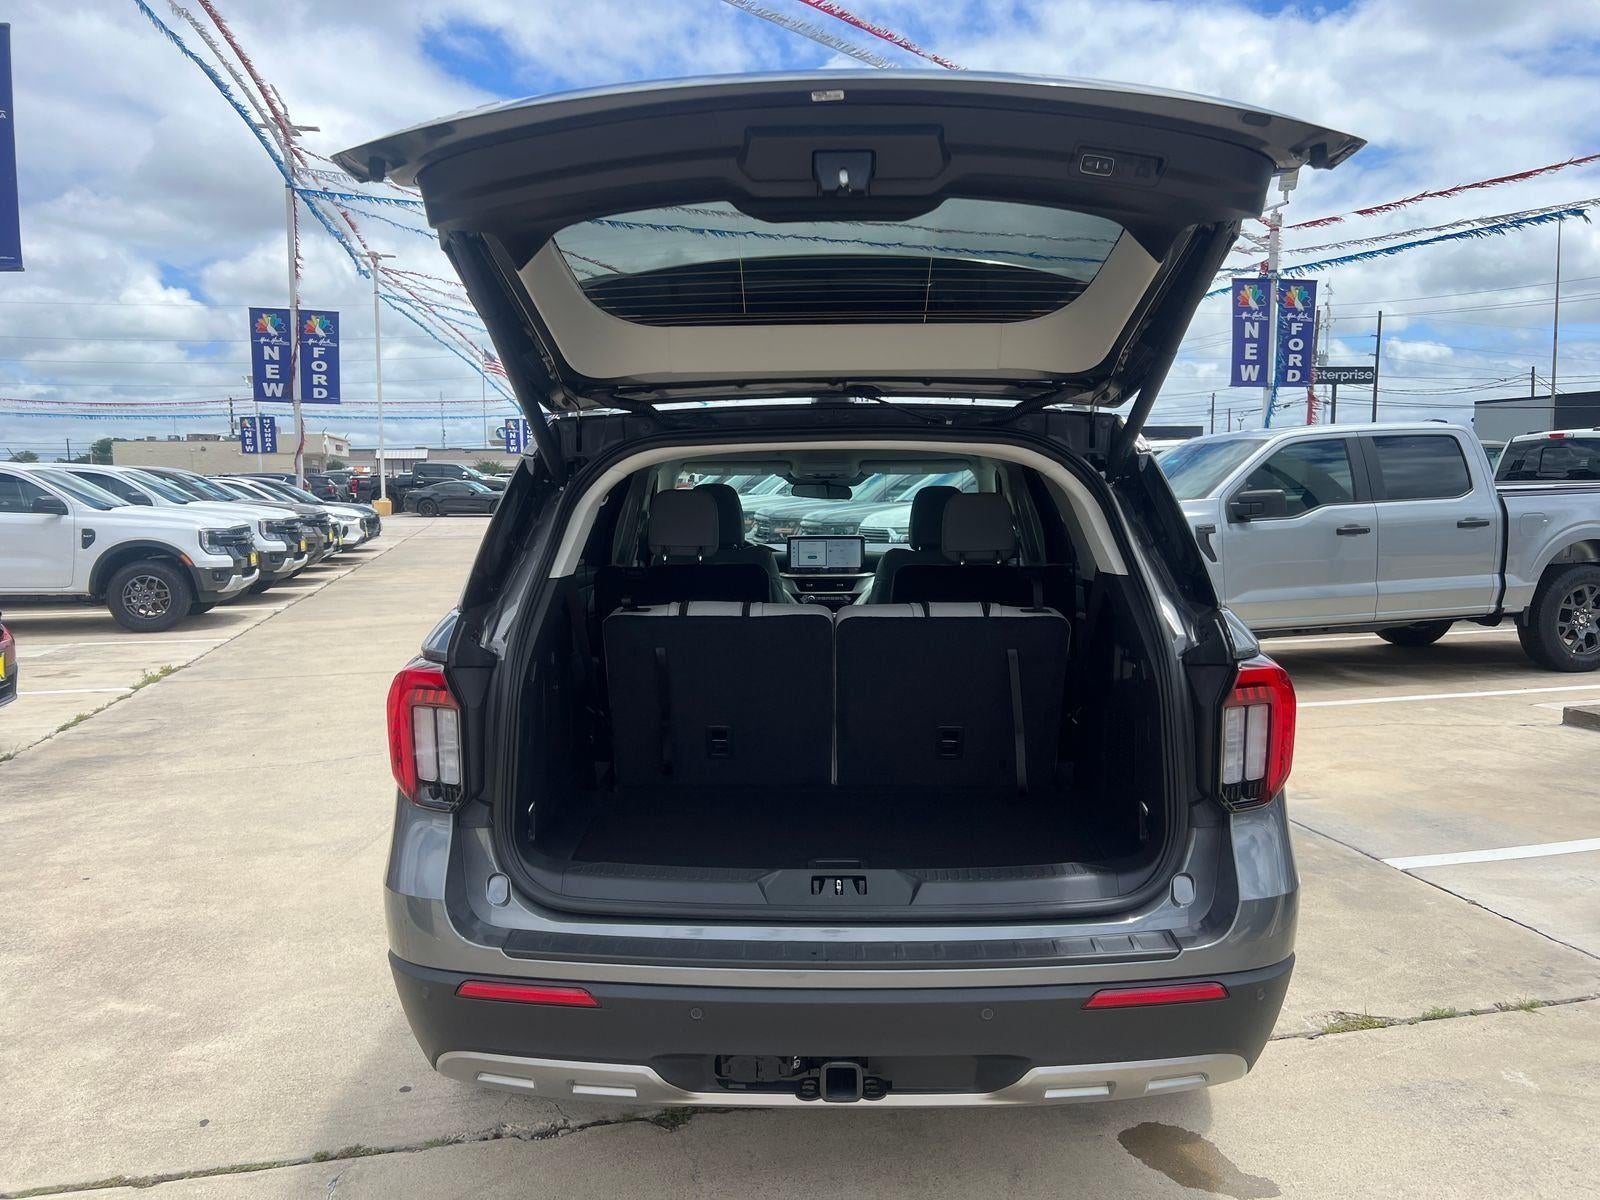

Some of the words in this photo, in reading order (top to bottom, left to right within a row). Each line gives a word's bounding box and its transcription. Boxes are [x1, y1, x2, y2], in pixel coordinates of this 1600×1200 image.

[262, 346, 284, 397] NEW
[1240, 322, 1260, 381] NEW
[1286, 322, 1304, 382] FORD
[311, 347, 328, 399] FORD
[1316, 369, 1373, 381] nterprise
[244, 431, 254, 452] NEW
[263, 419, 272, 451] HYUNDAI
[509, 432, 518, 452] NEW
